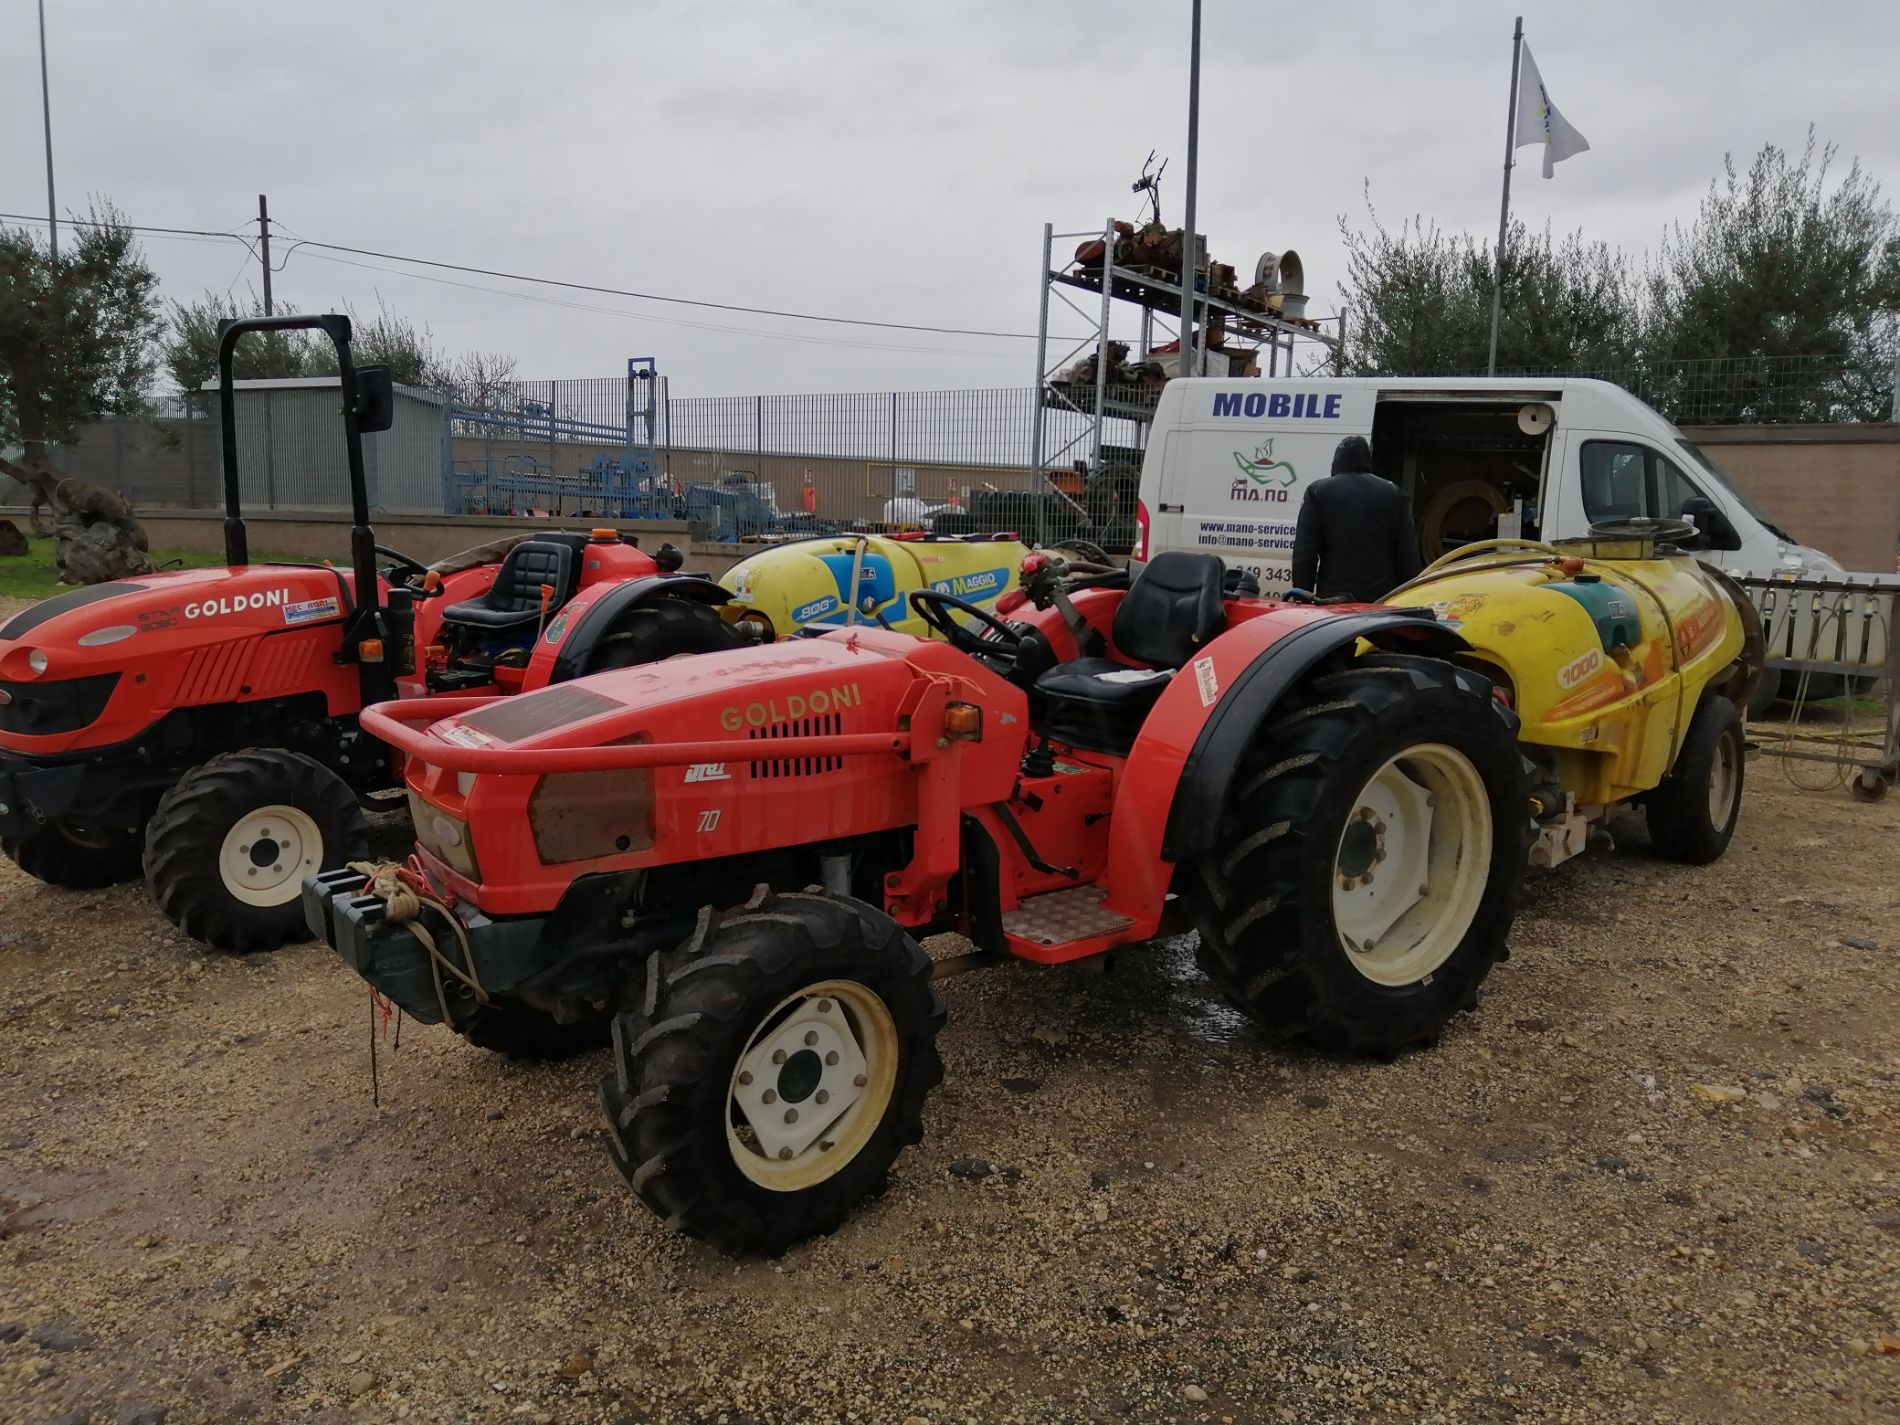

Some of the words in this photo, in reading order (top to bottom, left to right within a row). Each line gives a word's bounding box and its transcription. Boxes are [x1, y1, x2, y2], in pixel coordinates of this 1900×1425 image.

[1212, 392, 1342, 419] MOBILE
[184, 587, 289, 619] GOLDONI
[801, 599, 830, 620] 800
[1563, 651, 1600, 686] 1000
[720, 682, 861, 732] GOLDONI
[696, 809, 721, 833] 70
